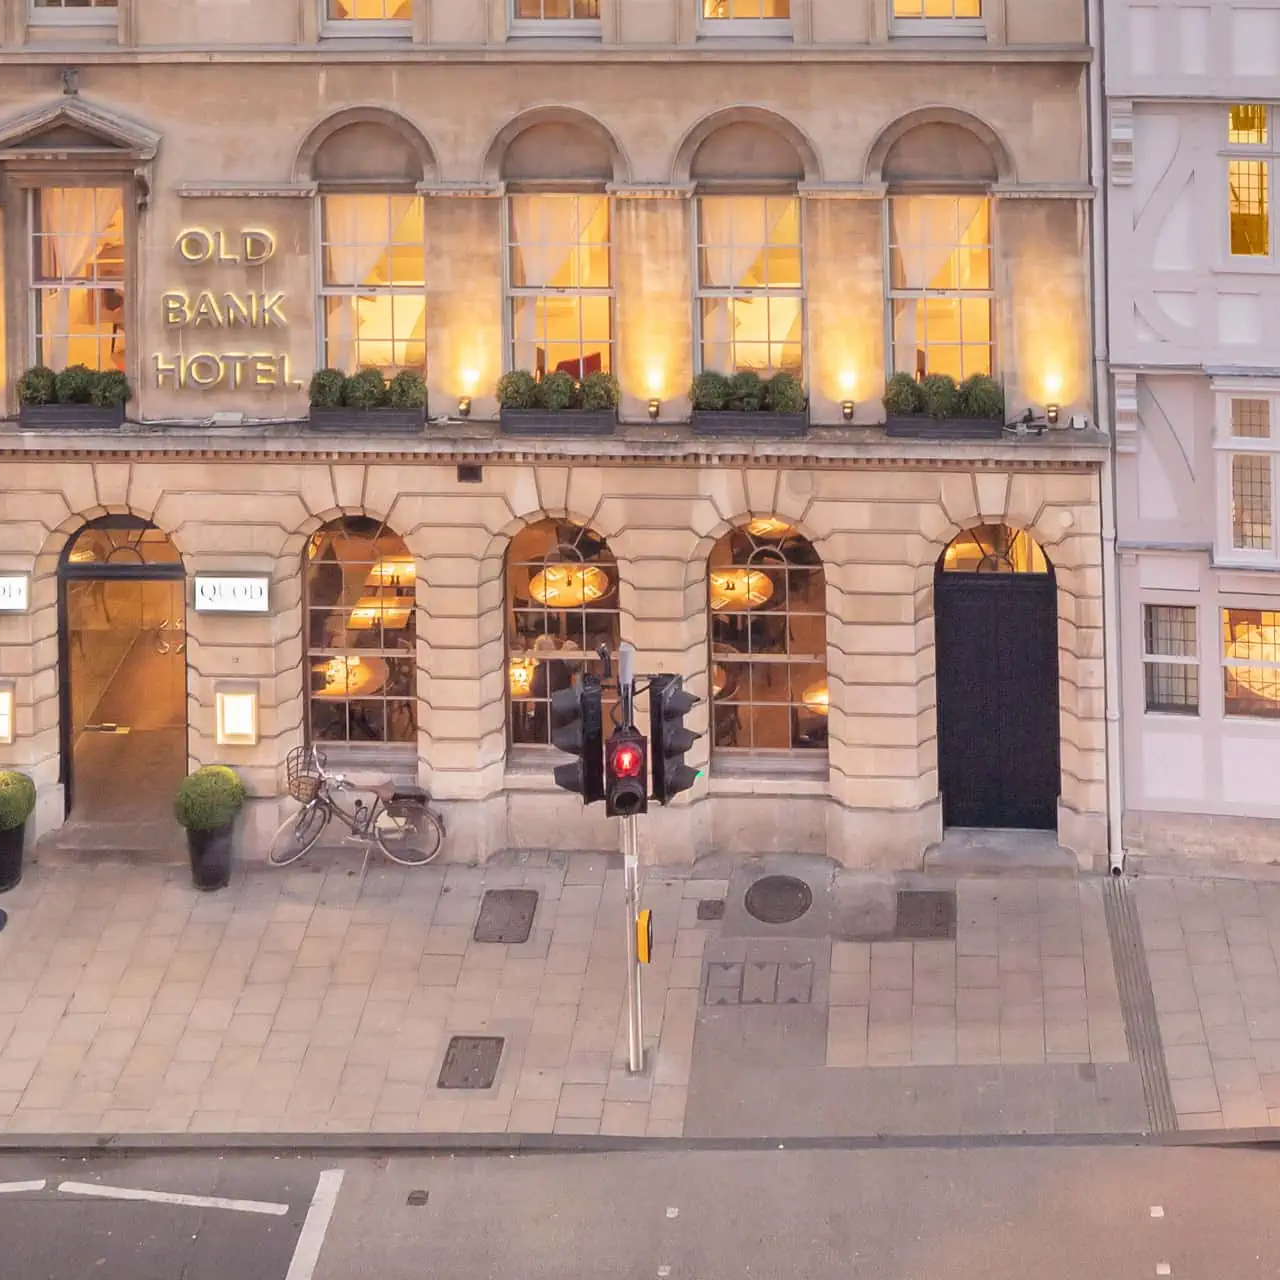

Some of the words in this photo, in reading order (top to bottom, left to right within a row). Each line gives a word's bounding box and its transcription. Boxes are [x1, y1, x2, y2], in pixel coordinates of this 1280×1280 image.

[175, 228, 276, 267] OLD
[161, 291, 288, 328] BANK
[152, 352, 304, 391] HOTEL
